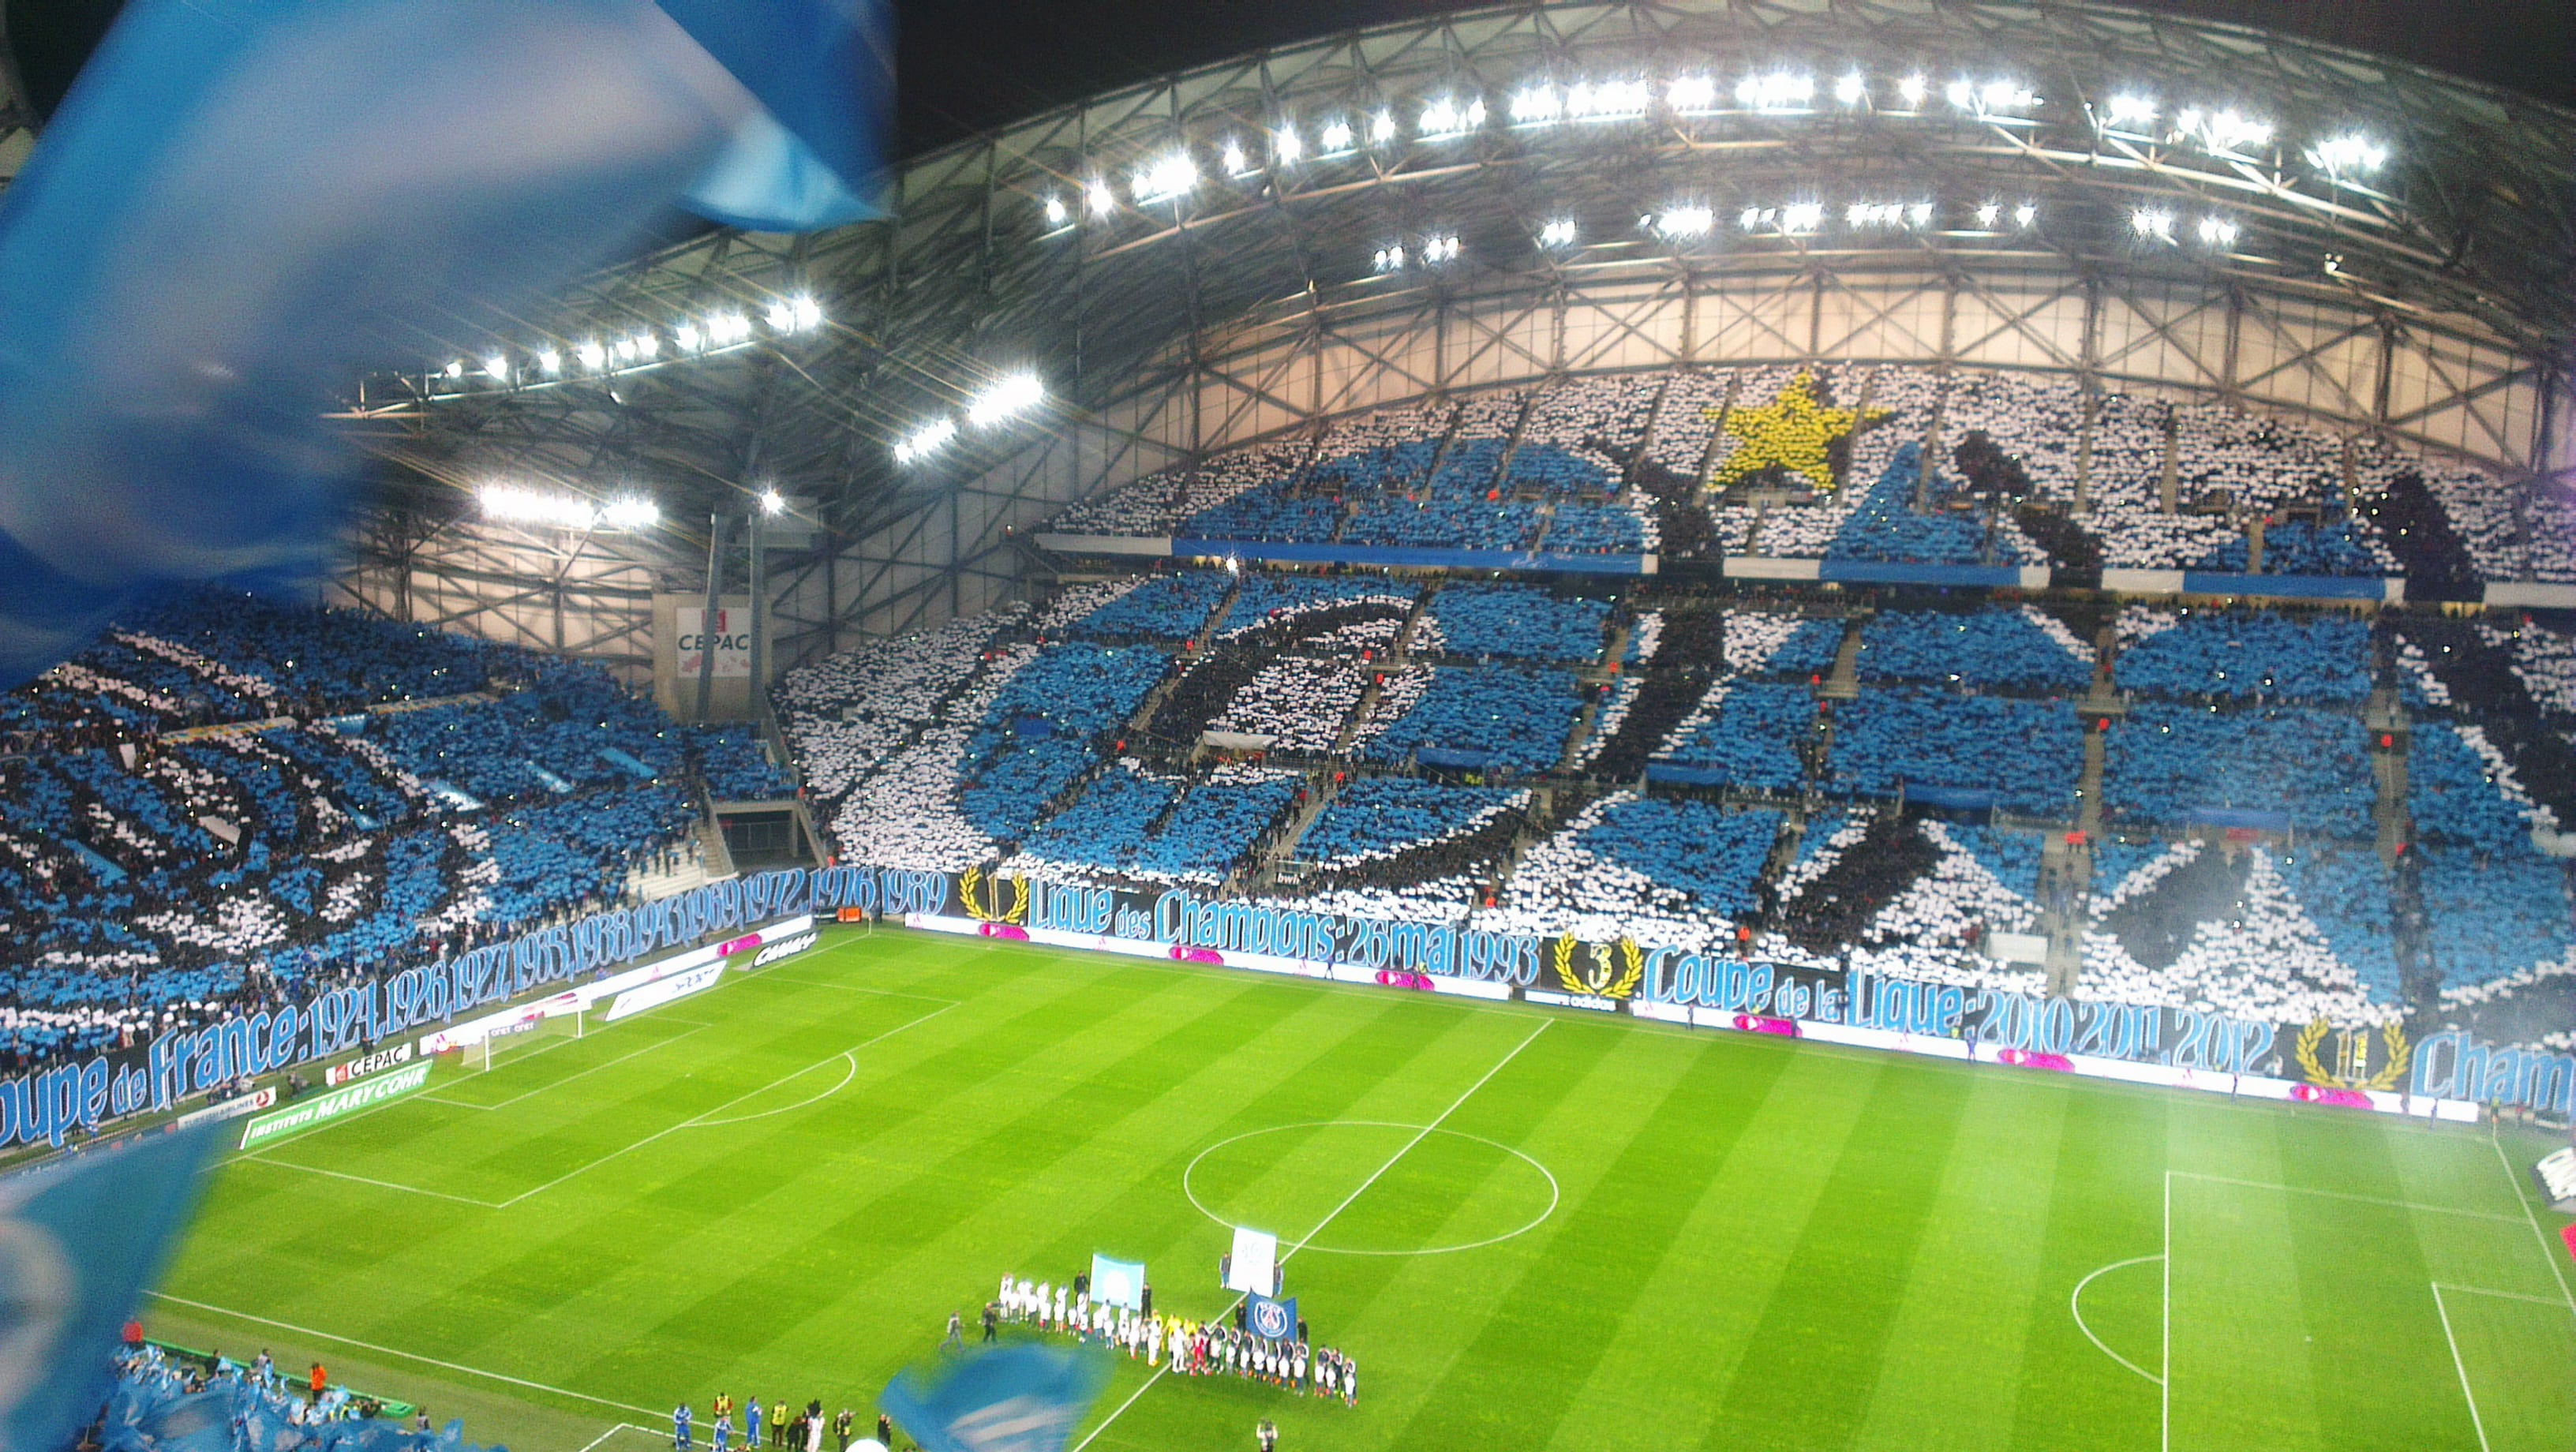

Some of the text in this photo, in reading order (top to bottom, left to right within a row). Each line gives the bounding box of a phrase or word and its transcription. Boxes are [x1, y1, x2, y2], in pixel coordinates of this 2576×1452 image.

[1028, 873, 1113, 934] Ligue
[1114, 902, 1151, 941] des
[1346, 915, 1390, 969] 26
[1390, 920, 1457, 975] mai
[1459, 929, 1540, 986] 1993
[111, 1062, 147, 1115] de
[878, 869, 948, 916] 1989
[1588, 941, 1612, 990] 3
[1643, 944, 1774, 1015] Coupe
[1775, 975, 1810, 1019] de
[1815, 979, 1840, 1023] la
[351, 1046, 404, 1077] CEPAC
[315, 1084, 375, 1120] MARY
